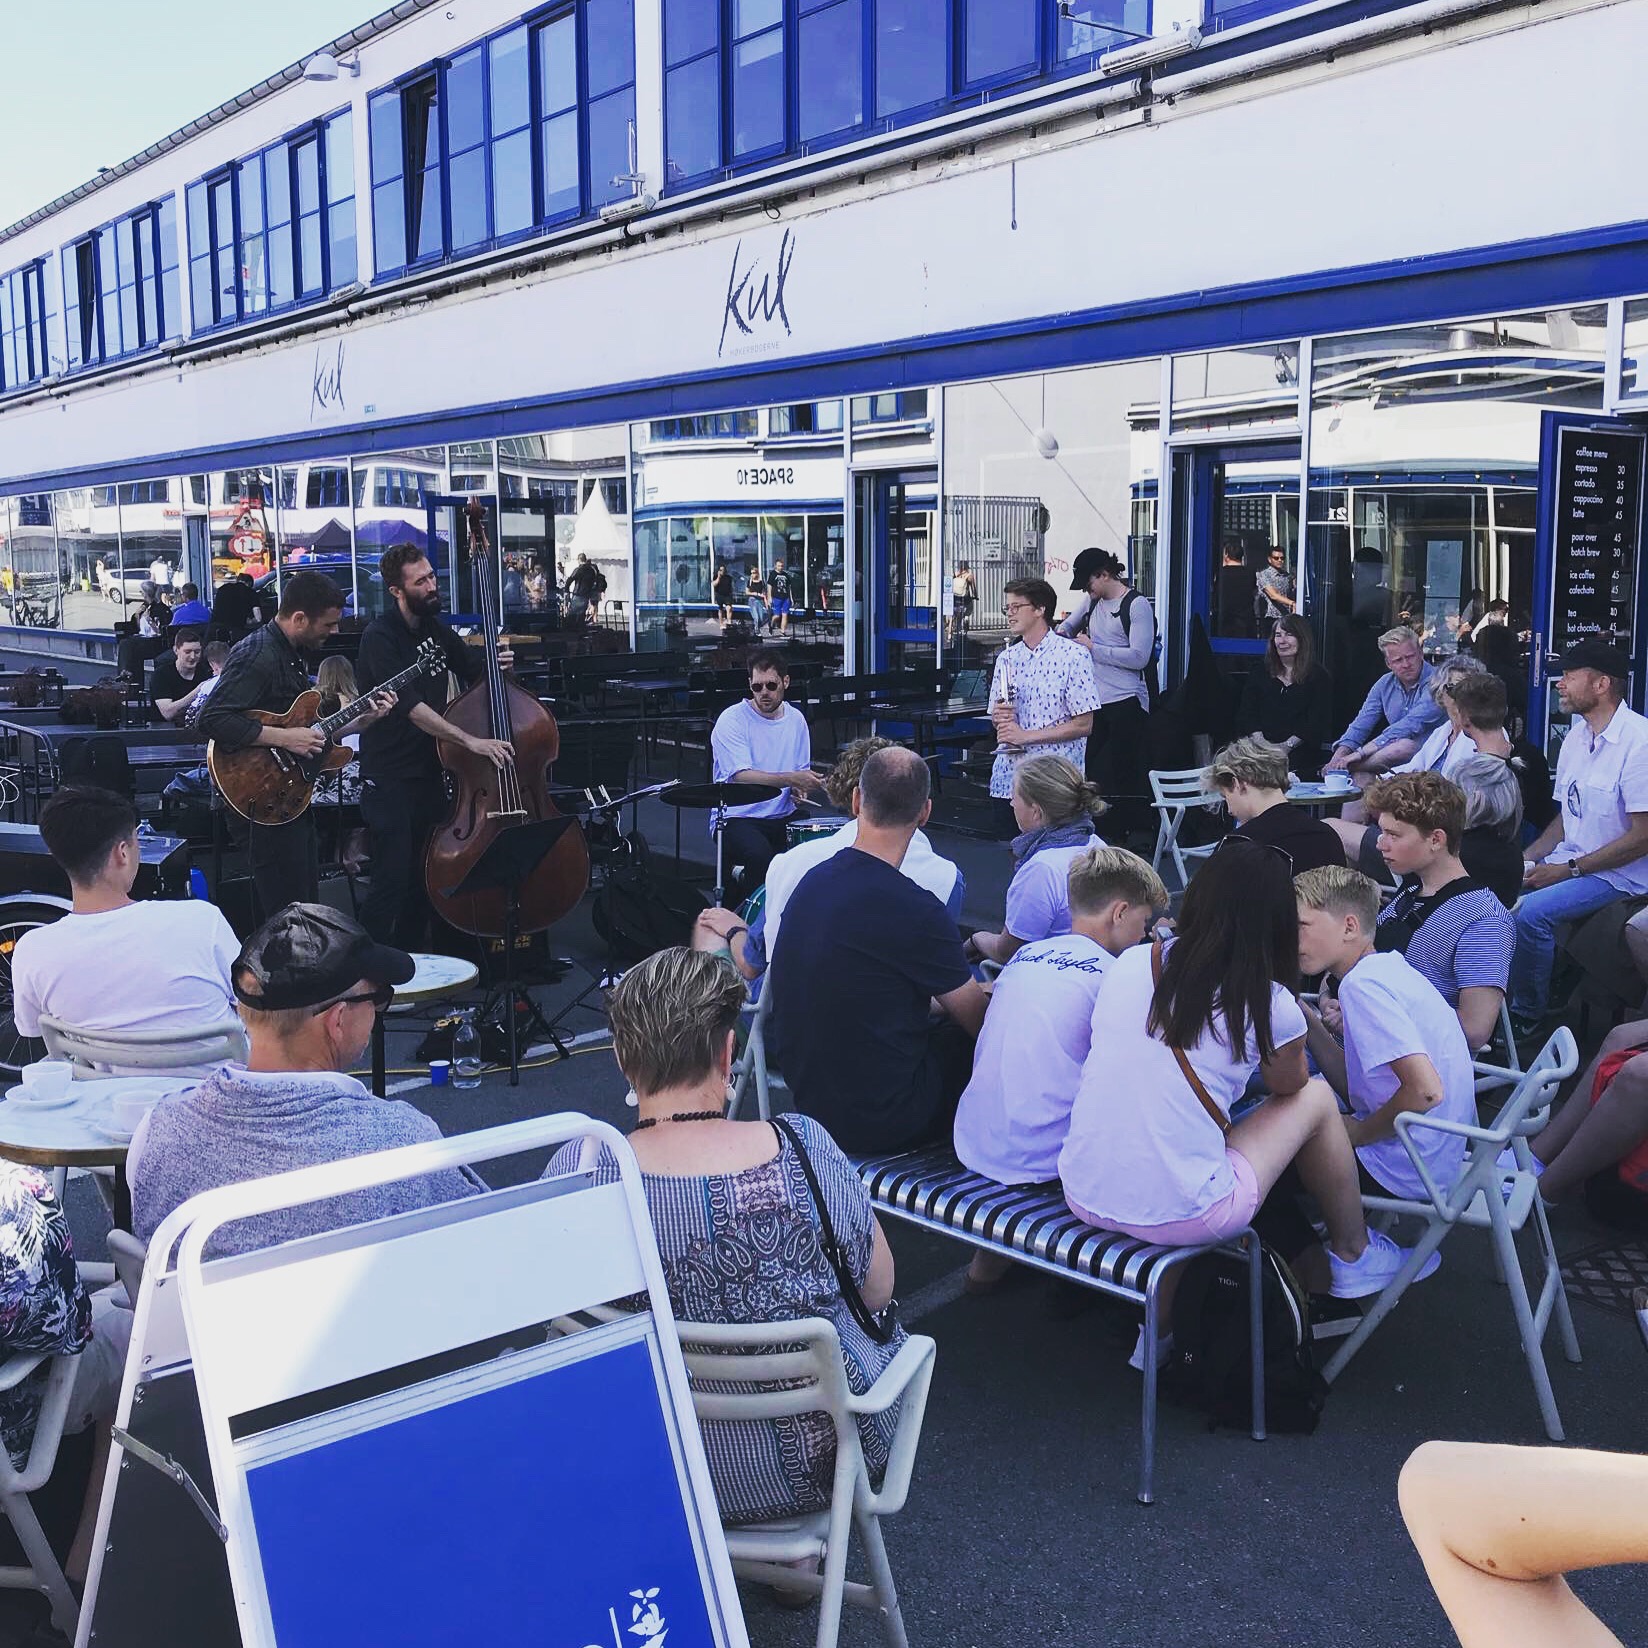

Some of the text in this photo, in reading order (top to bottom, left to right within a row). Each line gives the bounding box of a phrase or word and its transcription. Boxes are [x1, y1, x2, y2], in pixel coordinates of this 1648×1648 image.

[1575, 446, 1609, 459] coffee menu
[1575, 464, 1626, 475] espresso 30
[1574, 477, 1625, 490] cortado 35
[1573, 494, 1624, 506] cappuccino 40
[1572, 507, 1623, 520] latte 45
[1571, 532, 1622, 544] pour over 45
[1570, 546, 1621, 558] batch brew 30
[1569, 569, 1620, 580] ice coffee 45
[1610, 585, 1619, 595] 45
[1567, 609, 1577, 617] tea
[1567, 622, 1576, 633] hot
[1609, 622, 1617, 632] 45
